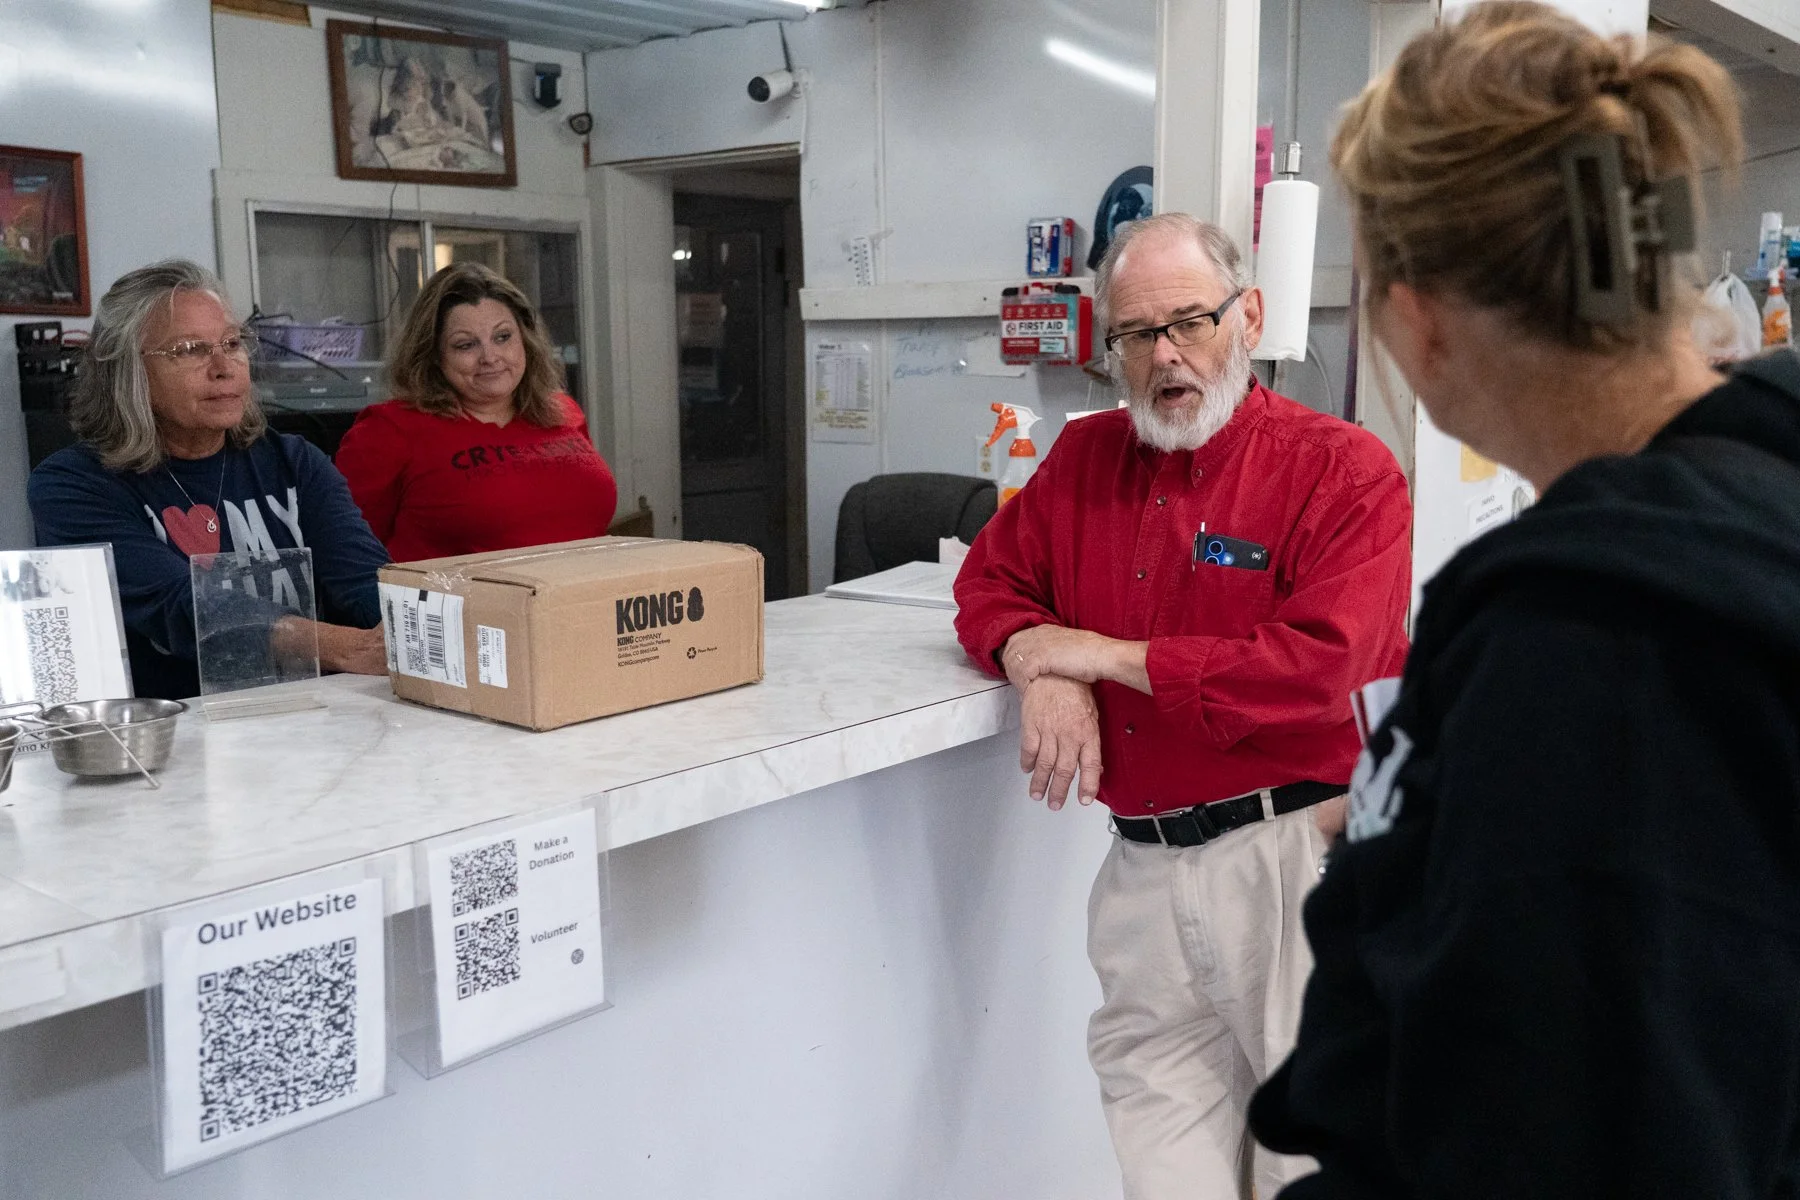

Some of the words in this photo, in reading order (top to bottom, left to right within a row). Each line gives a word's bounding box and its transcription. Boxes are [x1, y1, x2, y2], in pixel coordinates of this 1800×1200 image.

[1019, 321, 1044, 331] FIRST
[1047, 321, 1063, 330] AID
[223, 486, 305, 568] MY
[616, 590, 684, 634] KONG
[617, 636, 634, 646] KONG
[635, 633, 661, 643] COMPANY
[534, 838, 561, 851] Make
[562, 836, 569, 844] a
[529, 850, 575, 870] Donation
[198, 919, 248, 944] Our
[255, 894, 357, 930] Website
[531, 922, 578, 944] Volunteer
